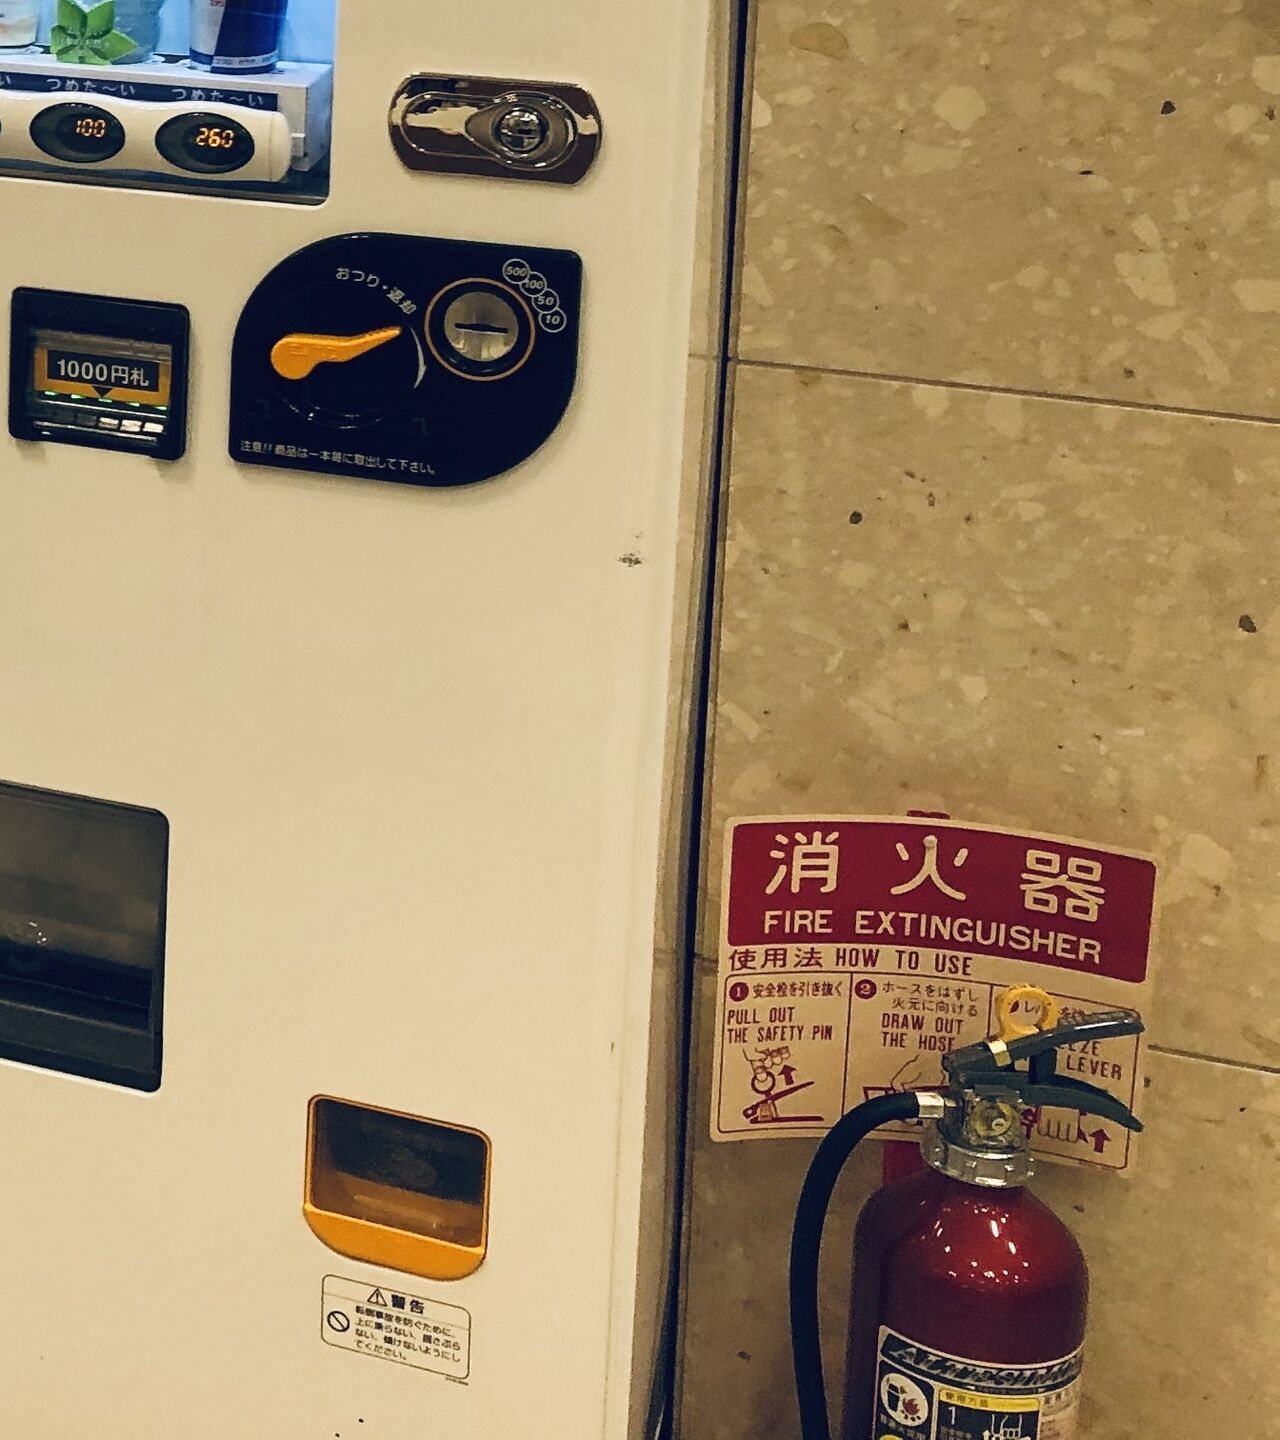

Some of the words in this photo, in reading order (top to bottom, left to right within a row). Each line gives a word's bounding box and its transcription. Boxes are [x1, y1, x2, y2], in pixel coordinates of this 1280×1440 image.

[171, 88, 263, 106] つめた〜い
[195, 127, 234, 148] 260
[544, 314, 560, 325] 10
[56, 358, 149, 387] 1000円札
[764, 830, 1106, 923] 消火器
[763, 909, 834, 935] FIRE
[855, 910, 1102, 965] EXTINGUISHER
[728, 947, 824, 971] 使用法
[835, 947, 881, 969] HOW
[894, 950, 921, 971] TO
[934, 953, 972, 976] USE
[881, 981, 979, 1003] ホースをはずし
[728, 1007, 764, 1025] PULL
[769, 1007, 797, 1024] OUT
[891, 998, 979, 1018] 火元に向ける
[727, 1026, 752, 1044] THE
[757, 1024, 805, 1042] SAFETY
[812, 1025, 833, 1041] PIN
[881, 1013, 927, 1034] DRAW
[934, 1017, 964, 1037] OUT
[881, 1031, 909, 1048] THE
[1065, 1055, 1123, 1081] LEVER
[392, 1293, 424, 1314] 警告
